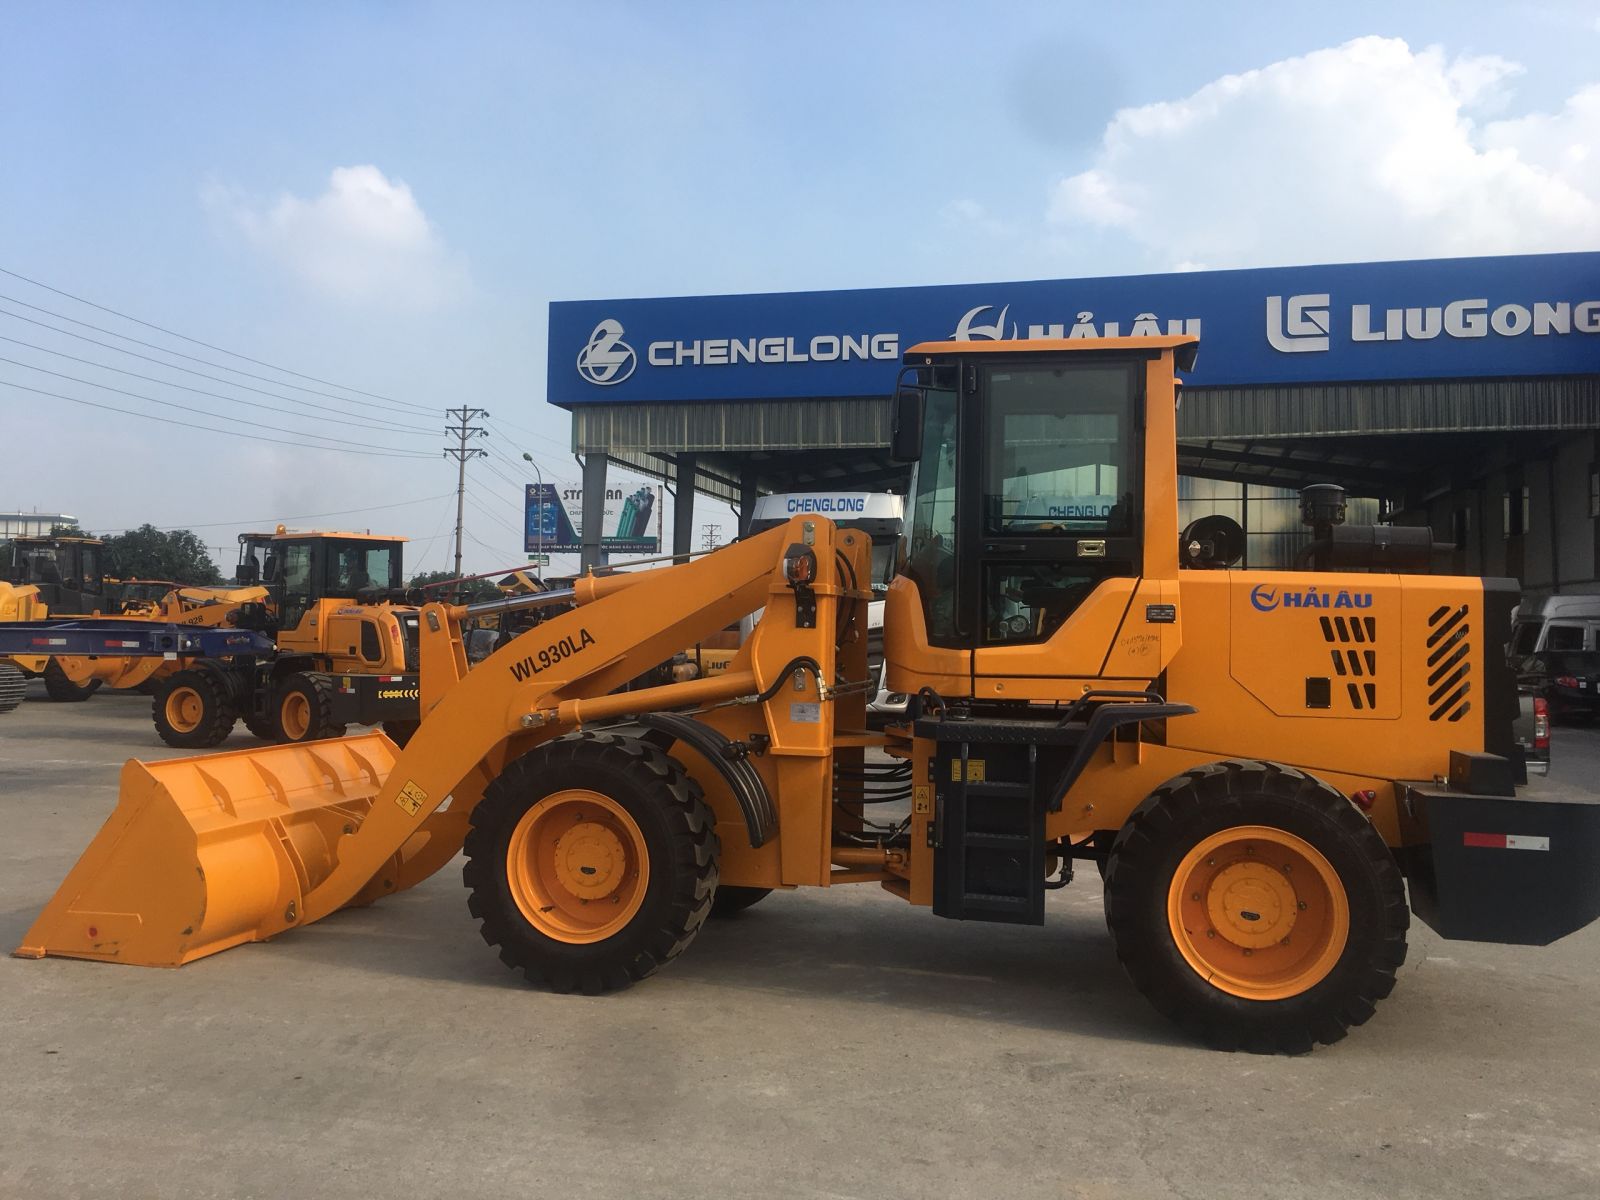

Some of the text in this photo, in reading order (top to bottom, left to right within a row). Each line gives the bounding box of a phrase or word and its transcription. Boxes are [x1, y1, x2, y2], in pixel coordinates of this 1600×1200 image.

[649, 334, 899, 366] CHENGLONG
[787, 498, 865, 512] CHENGLONG
[1284, 587, 1372, 608] HẢI ÂU
[509, 628, 596, 682] WL930LA
